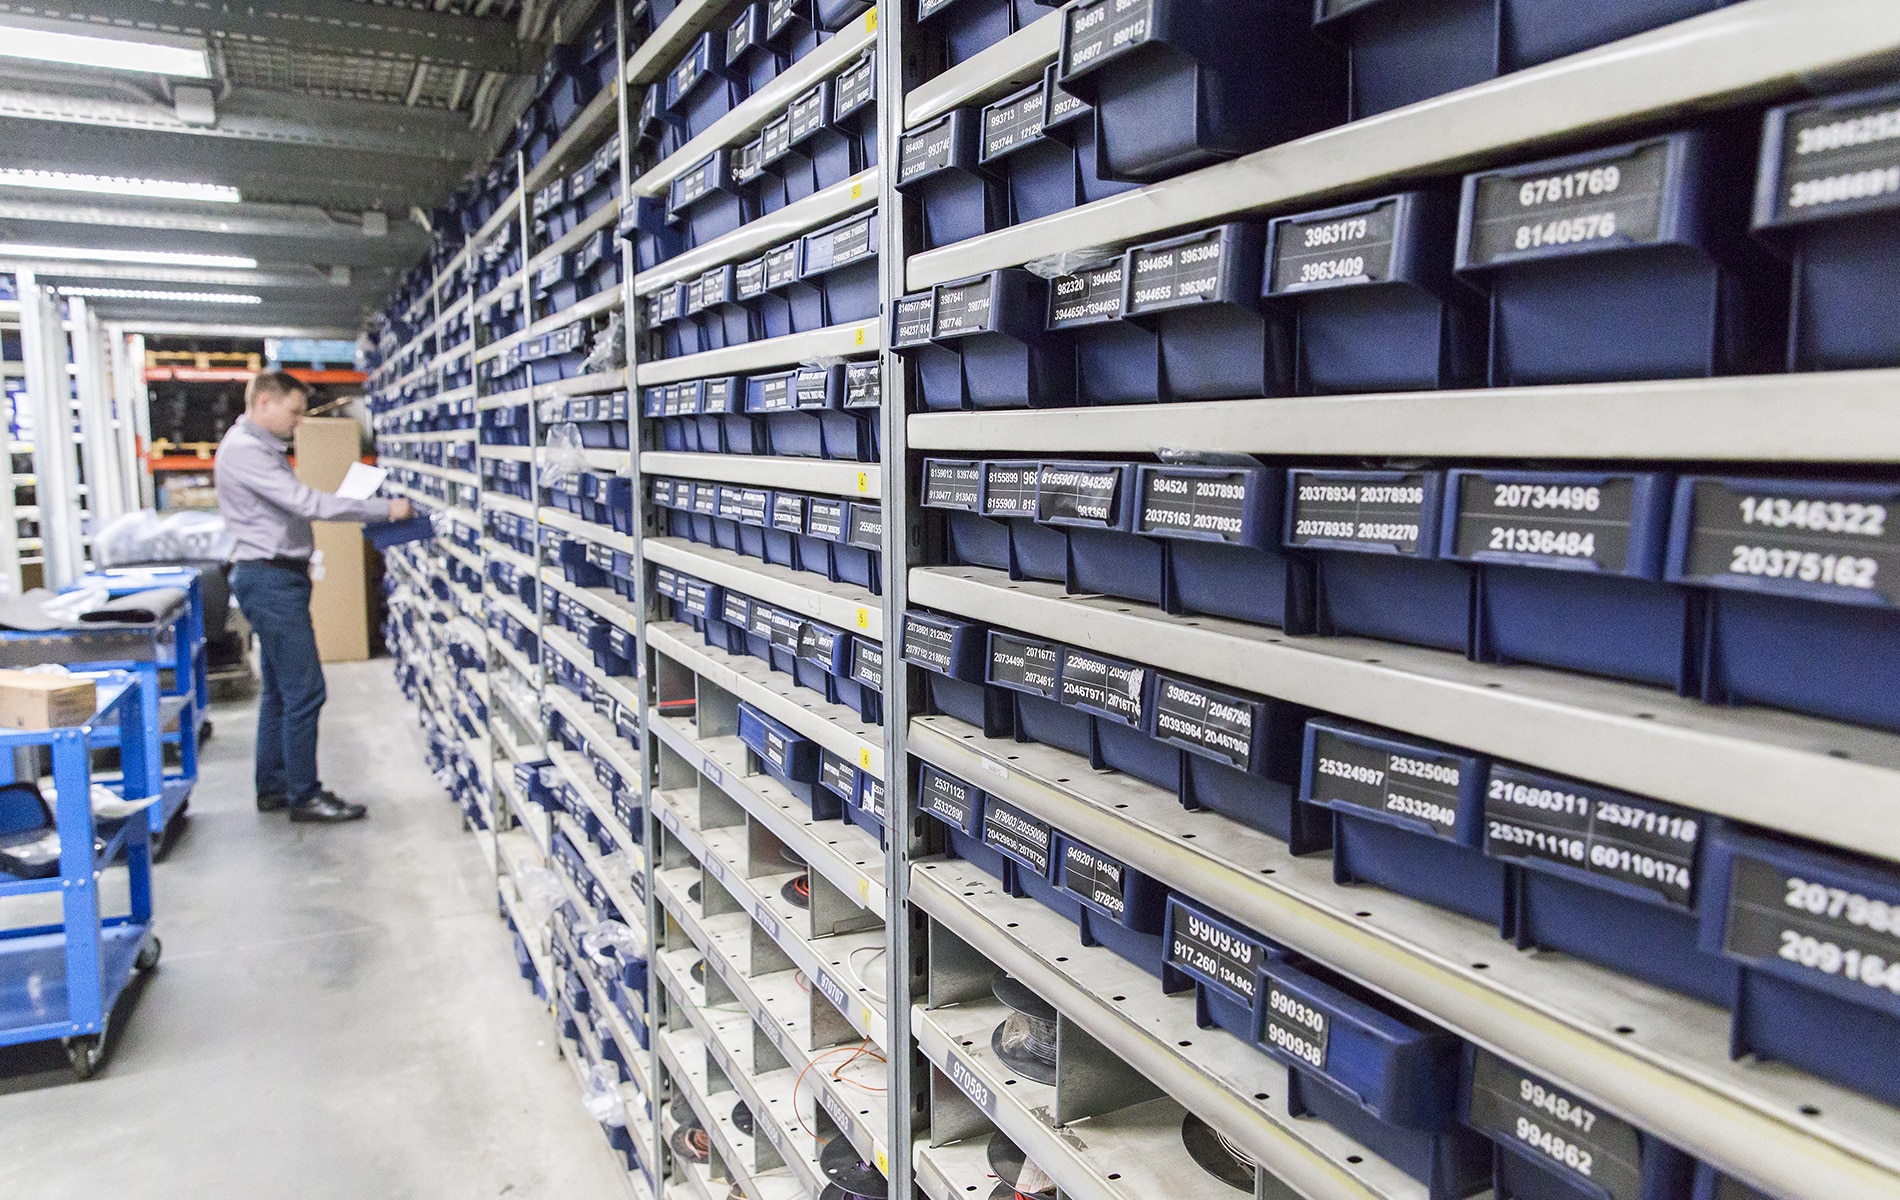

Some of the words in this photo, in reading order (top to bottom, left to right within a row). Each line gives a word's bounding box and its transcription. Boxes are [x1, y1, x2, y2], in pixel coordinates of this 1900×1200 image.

[991, 109, 1015, 128] 993713
[990, 134, 1014, 152] 993744
[1519, 166, 1621, 206] 6781769
[1304, 219, 1367, 248] 3963173
[1515, 213, 1616, 250] 8140576
[1137, 253, 1174, 273] 3944654
[1180, 243, 1220, 264] 3963046
[1301, 256, 1365, 283] 3963409
[1057, 278, 1085, 296] 982320
[1091, 268, 1122, 287] 3944652
[1134, 285, 1172, 303] 3944655
[1178, 276, 1217, 296] 3963047
[988, 472, 1018, 484] 8155899
[1041, 472, 1078, 487] 8155901
[1080, 475, 1114, 490] 948296
[1153, 478, 1188, 495] 984524
[1196, 482, 1245, 500] 20378930
[986, 498, 1017, 510] 8155900
[1299, 485, 1356, 503] 20378934
[1360, 486, 1424, 504] 20378936
[1494, 484, 1601, 512] 20734496
[1145, 508, 1191, 527] 20375163
[1193, 513, 1243, 533] 20378932
[1296, 520, 1355, 537] 20378935
[1357, 523, 1419, 541] 20382270
[1739, 496, 1887, 537] 14346322
[1488, 527, 1596, 557] 21336484
[1730, 546, 1880, 589] 20375162
[994, 652, 1025, 668] 20734499
[1066, 655, 1107, 675] 22966698
[1063, 682, 1105, 703] 20467971
[1167, 685, 1207, 709] 3986251
[1159, 714, 1202, 740] 20393964
[1318, 757, 1384, 787] 25324997
[1390, 755, 1460, 787] 25325008
[934, 776, 965, 800] 25371123
[1489, 780, 1589, 817] 21680311
[933, 797, 963, 822] 25332890
[1387, 793, 1456, 827] 25332840
[1067, 847, 1095, 868] 949201
[1489, 821, 1586, 861] 25371116
[1590, 844, 1692, 892] 60110174
[1094, 890, 1124, 912] 978299
[1189, 915, 1252, 964] 990939
[1174, 940, 1218, 976] 917.260
[1270, 990, 1324, 1033] 990330
[1268, 1023, 1322, 1067] 990938
[953, 1060, 989, 1107] 970583
[1519, 1078, 1597, 1133] 994847
[1515, 1116, 1594, 1177] 994862
